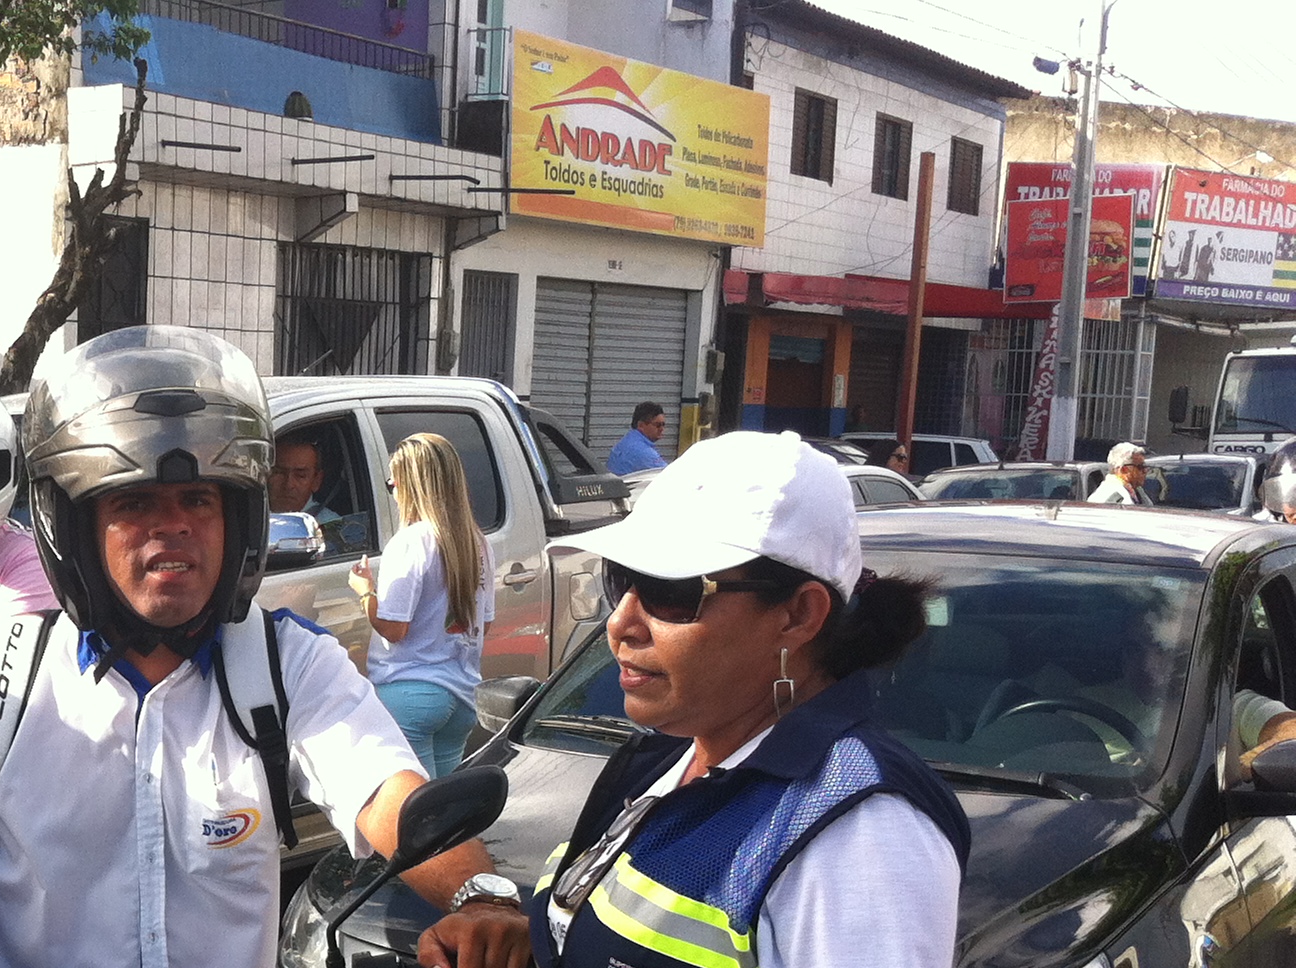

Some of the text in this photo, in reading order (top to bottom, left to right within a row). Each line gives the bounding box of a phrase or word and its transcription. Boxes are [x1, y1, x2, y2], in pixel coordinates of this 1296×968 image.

[535, 114, 673, 175] ANDRADE
[544, 160, 664, 199] Toldos e Esquadrias
[1219, 247, 1273, 265] SERGIPANO
[1183, 285, 1219, 299] PREÇO
[1221, 289, 1254, 300] BAIXO
[1265, 292, 1291, 303] AQUI
[1214, 445, 1266, 454] CARGO
